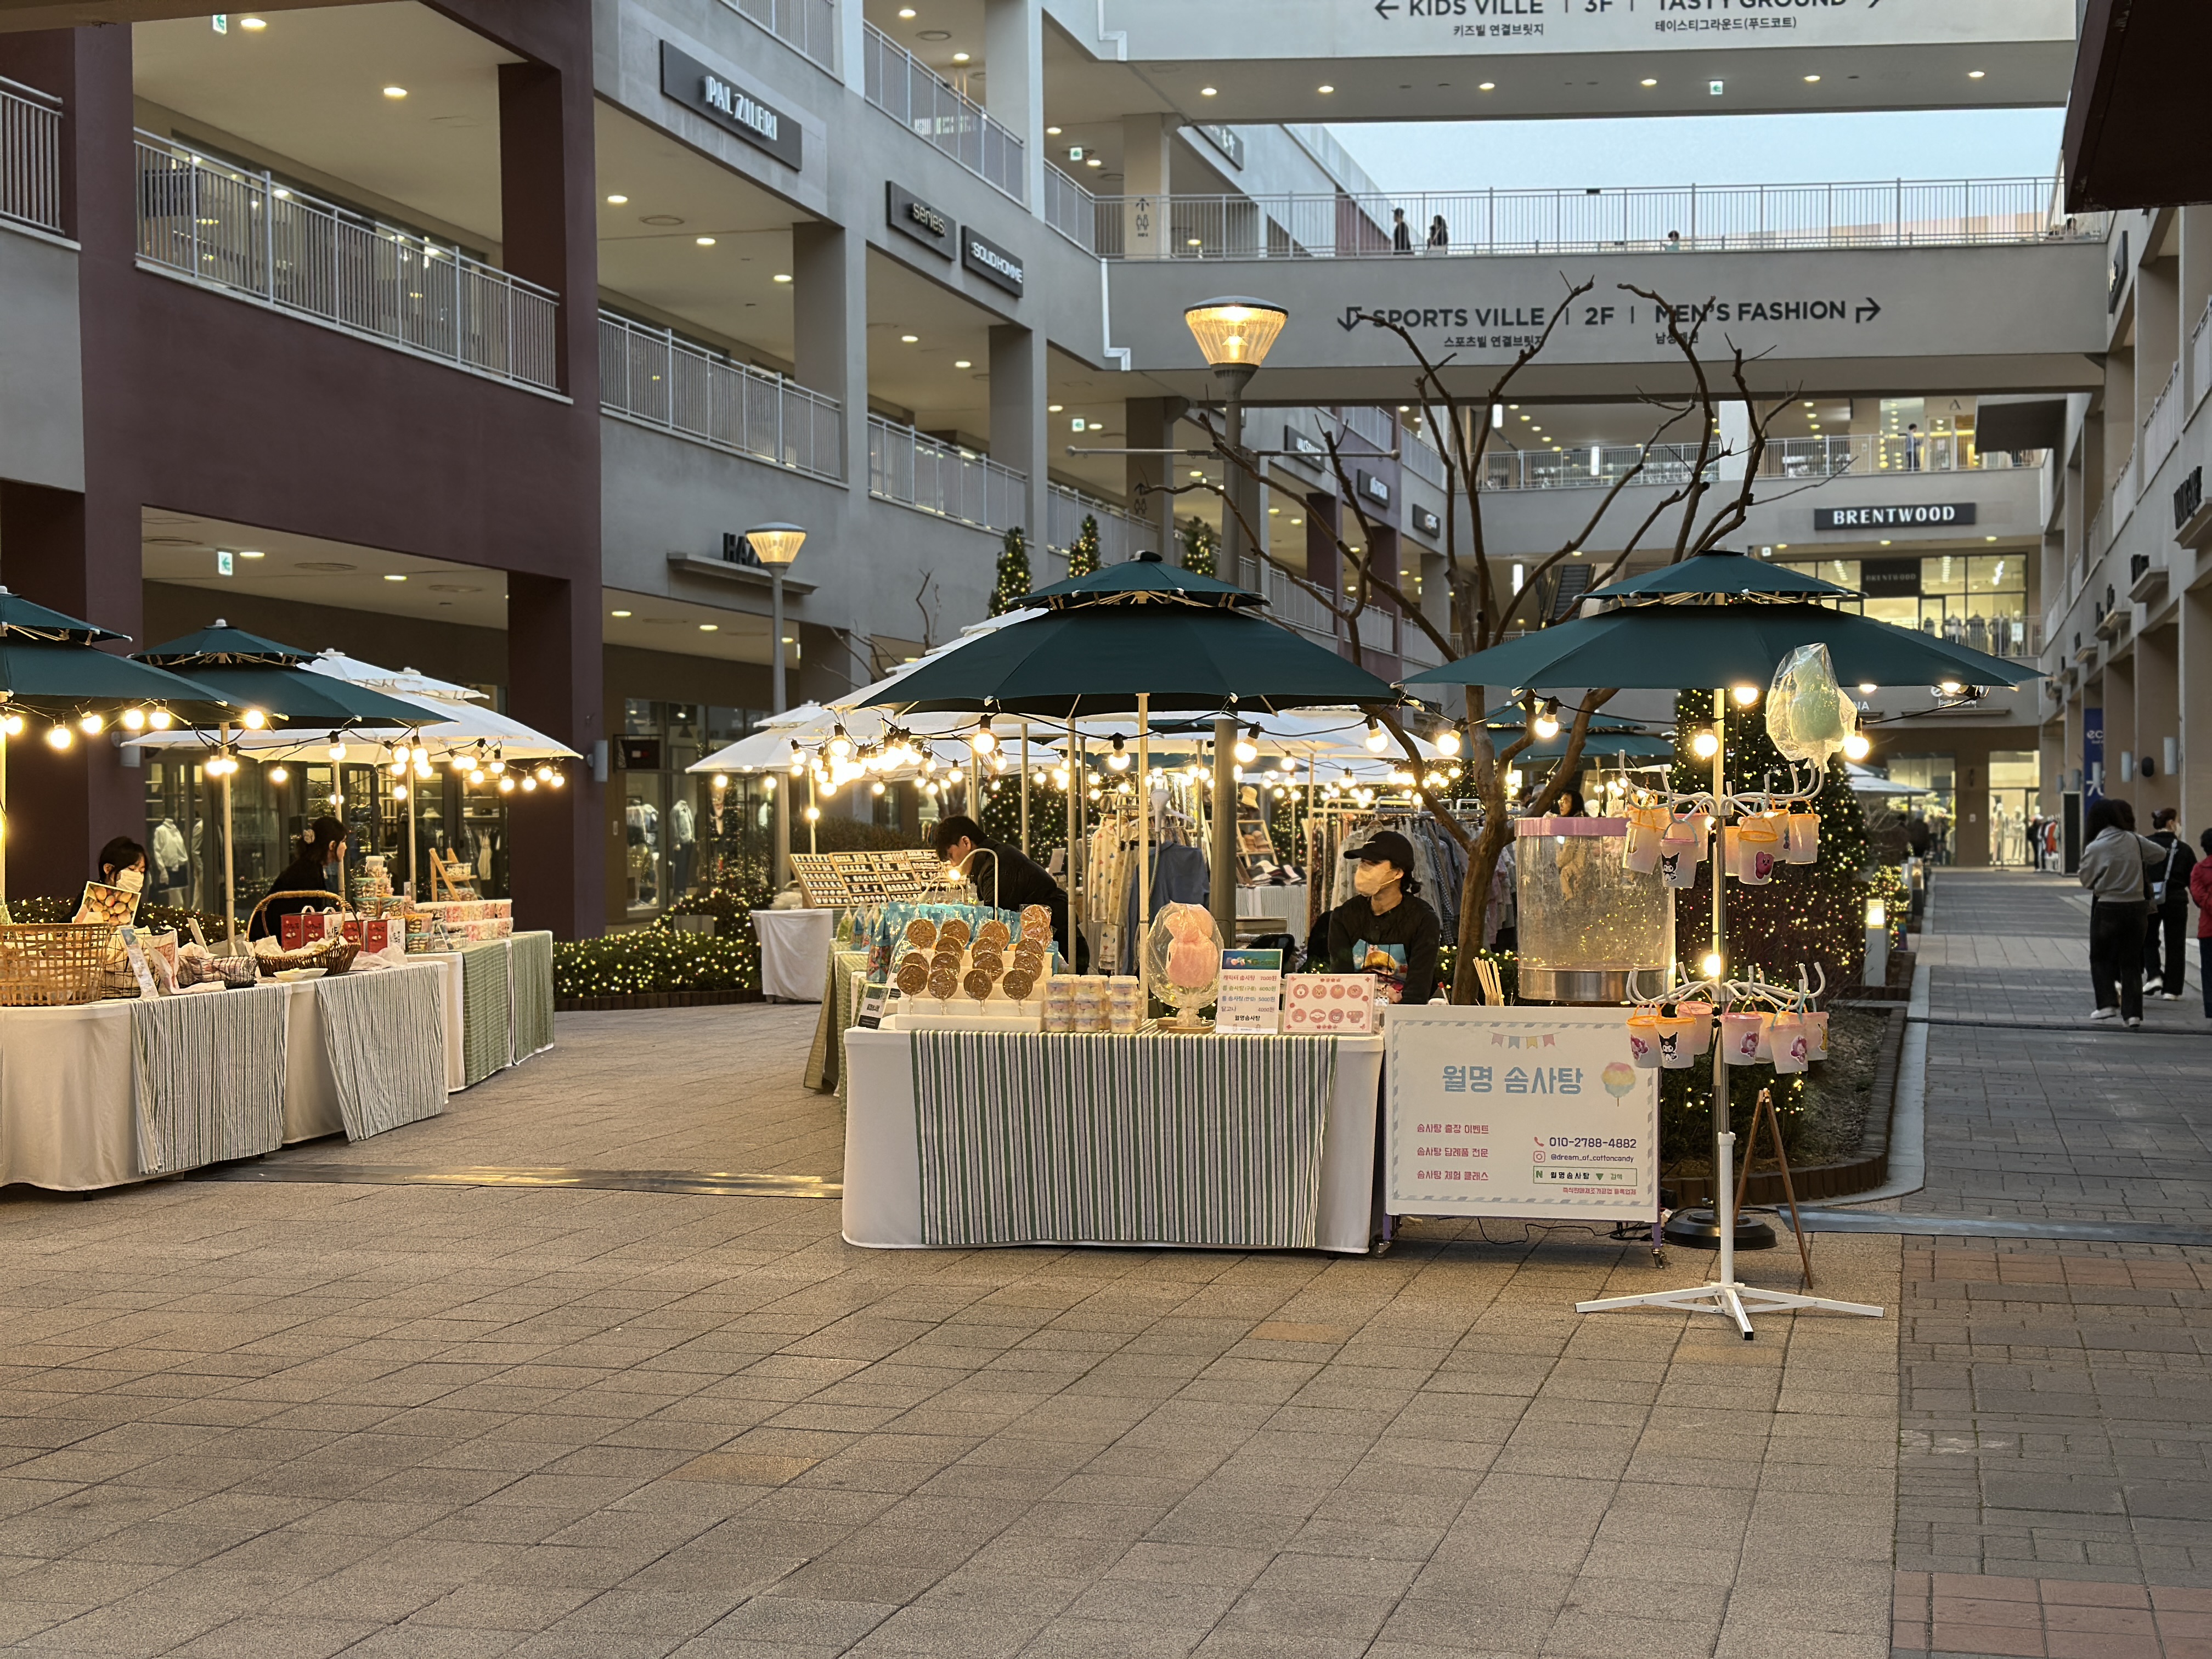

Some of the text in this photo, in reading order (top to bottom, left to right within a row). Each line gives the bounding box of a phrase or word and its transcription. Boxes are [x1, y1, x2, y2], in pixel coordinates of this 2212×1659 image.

[1410, 0, 1466, 16] KIDS
[1475, 0, 1544, 14] VILLE
[1453, 23, 1544, 37] 키즈빌 연결브릿지
[1655, 16, 1797, 32] 테이스티그라운드(푸드코트)
[706, 76, 777, 141] PAL ZILERI
[1373, 308, 1468, 328] SPORTS
[1475, 307, 1544, 327] VILLE
[1585, 307, 1615, 325] 2F
[1737, 300, 1846, 321] FASHION
[1444, 335, 1487, 348] 스포츠빌
[1833, 505, 1955, 525] BRENTWOOD
[1442, 1065, 1584, 1094] 월명 솜사탕
[1417, 1124, 1442, 1133] 솜사탕
[1464, 1125, 1489, 1134] 이벤트
[1549, 1137, 1637, 1149] 010-2788-4882
[1417, 1147, 1442, 1156] 솜사탕
[1472, 1148, 1488, 1158] 전문
[1550, 1153, 1634, 1163] @dream_of_cottoncandy
[1417, 1170, 1489, 1181] 솜사탕 체험 클래스
